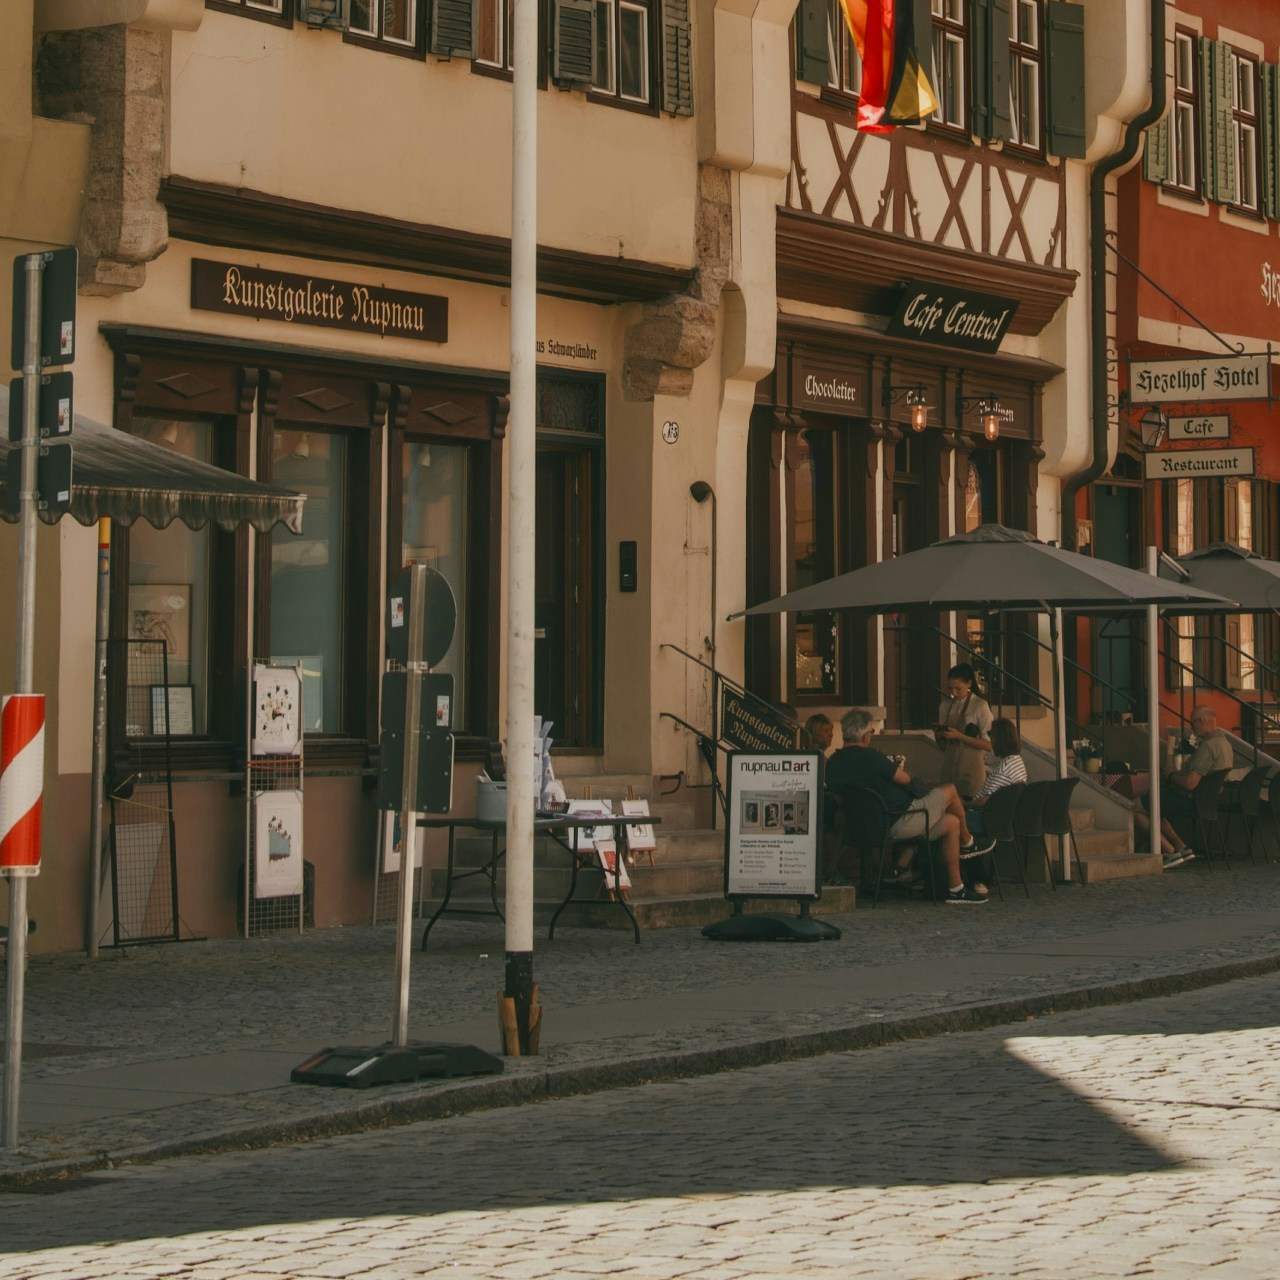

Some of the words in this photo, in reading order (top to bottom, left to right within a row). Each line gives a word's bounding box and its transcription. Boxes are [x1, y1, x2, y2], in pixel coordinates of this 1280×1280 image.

[223, 266, 344, 322] Kunstgalerie
[351, 286, 425, 334] Nupnau
[943, 301, 1010, 342] Central
[536, 342, 545, 354] us
[805, 374, 856, 401] Chocolatier
[1136, 367, 1208, 394] Hezelhof
[1213, 366, 1261, 391] Hotel
[1183, 418, 1214, 436] Cafe
[1161, 456, 1239, 473] Restaurant
[727, 699, 793, 750] Kunstgalerie
[730, 721, 770, 751] Nupna
[740, 761, 781, 775] nupnau
[793, 760, 811, 772] art
